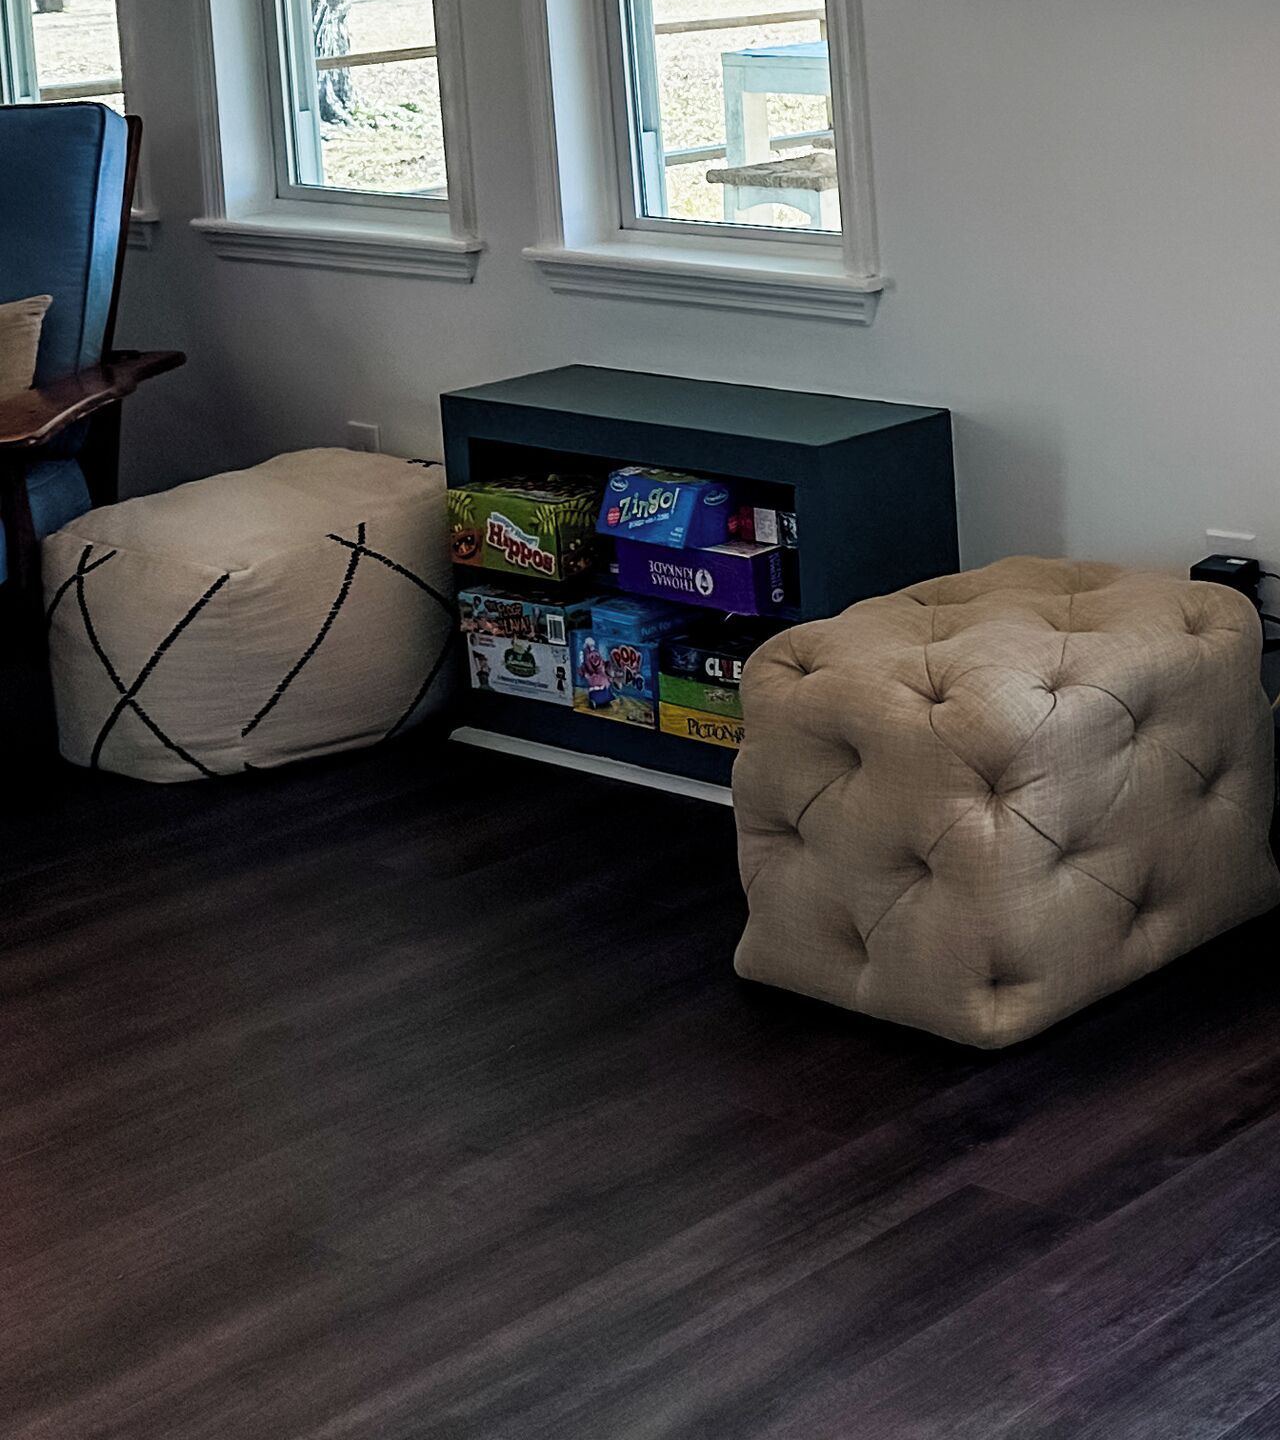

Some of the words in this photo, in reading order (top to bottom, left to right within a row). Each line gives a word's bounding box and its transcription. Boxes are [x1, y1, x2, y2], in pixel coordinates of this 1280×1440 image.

[619, 487, 680, 524] Zingo!
[486, 518, 555, 575] Hippos
[648, 560, 693, 580] KINKADE
[652, 573, 695, 592] THOMAS
[705, 657, 742, 681] CLUE
[687, 718, 746, 743] PICTIONAR
